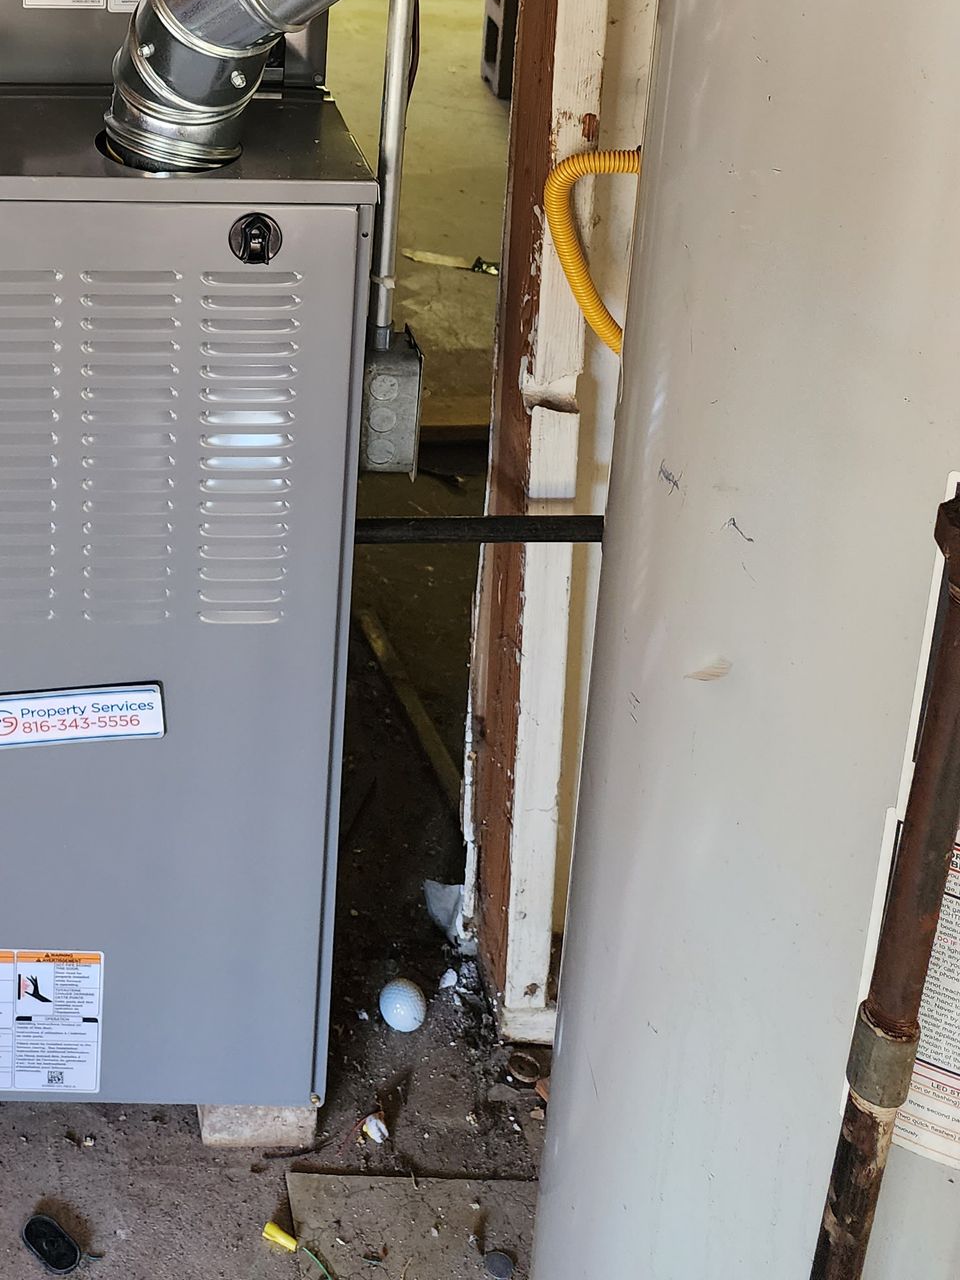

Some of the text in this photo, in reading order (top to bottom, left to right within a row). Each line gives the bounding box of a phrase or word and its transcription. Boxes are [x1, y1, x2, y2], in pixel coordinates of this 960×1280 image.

[20, 704, 87, 719] Property
[91, 701, 154, 713] Services
[22, 714, 140, 734] 816-343-5556
[937, 935, 948, 943] DO
[931, 1082, 948, 1092] LED
[926, 1107, 951, 1120] second
